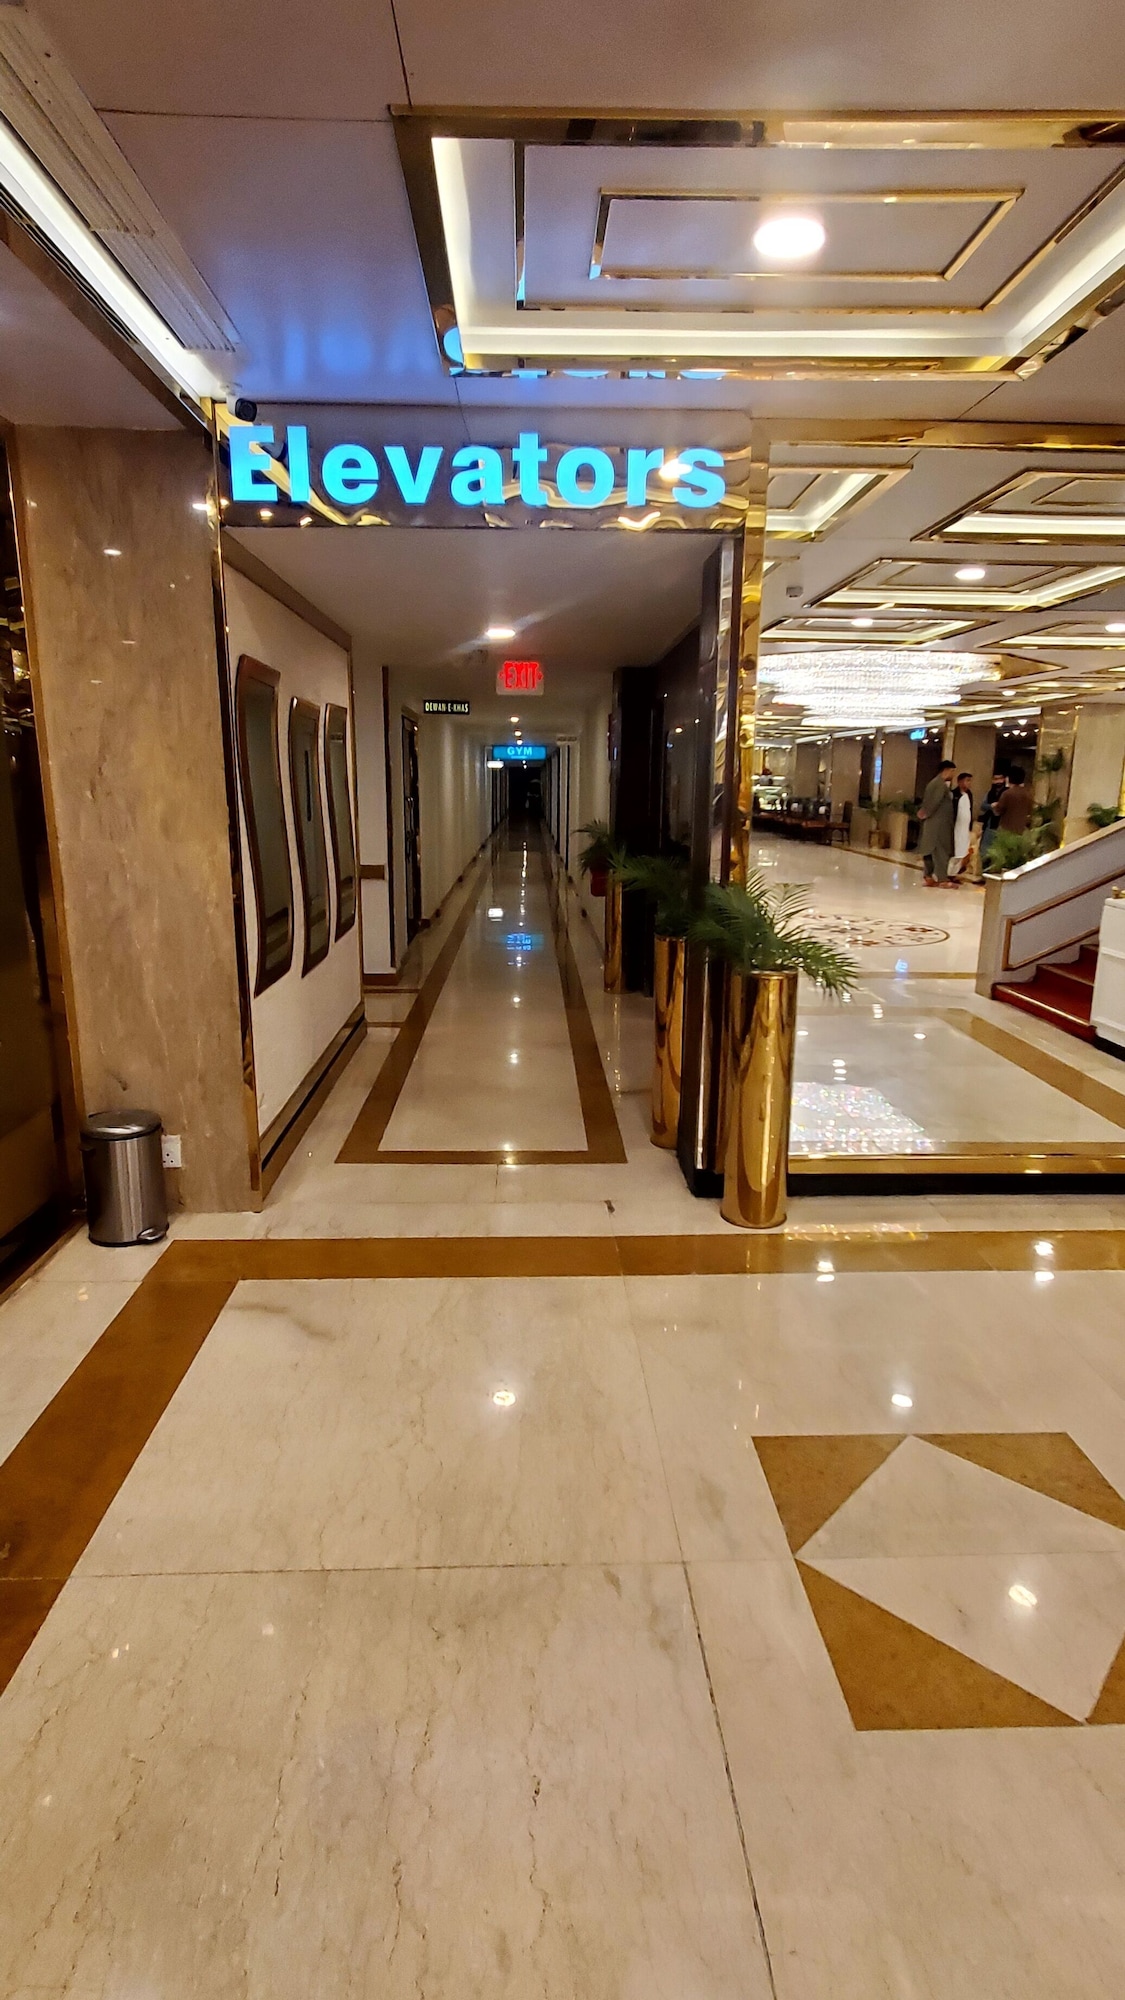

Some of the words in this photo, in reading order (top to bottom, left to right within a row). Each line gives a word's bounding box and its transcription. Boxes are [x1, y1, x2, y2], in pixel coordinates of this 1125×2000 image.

[228, 425, 726, 509] Elevators
[504, 662, 539, 689] EXIT
[507, 746, 533, 756] GYM
